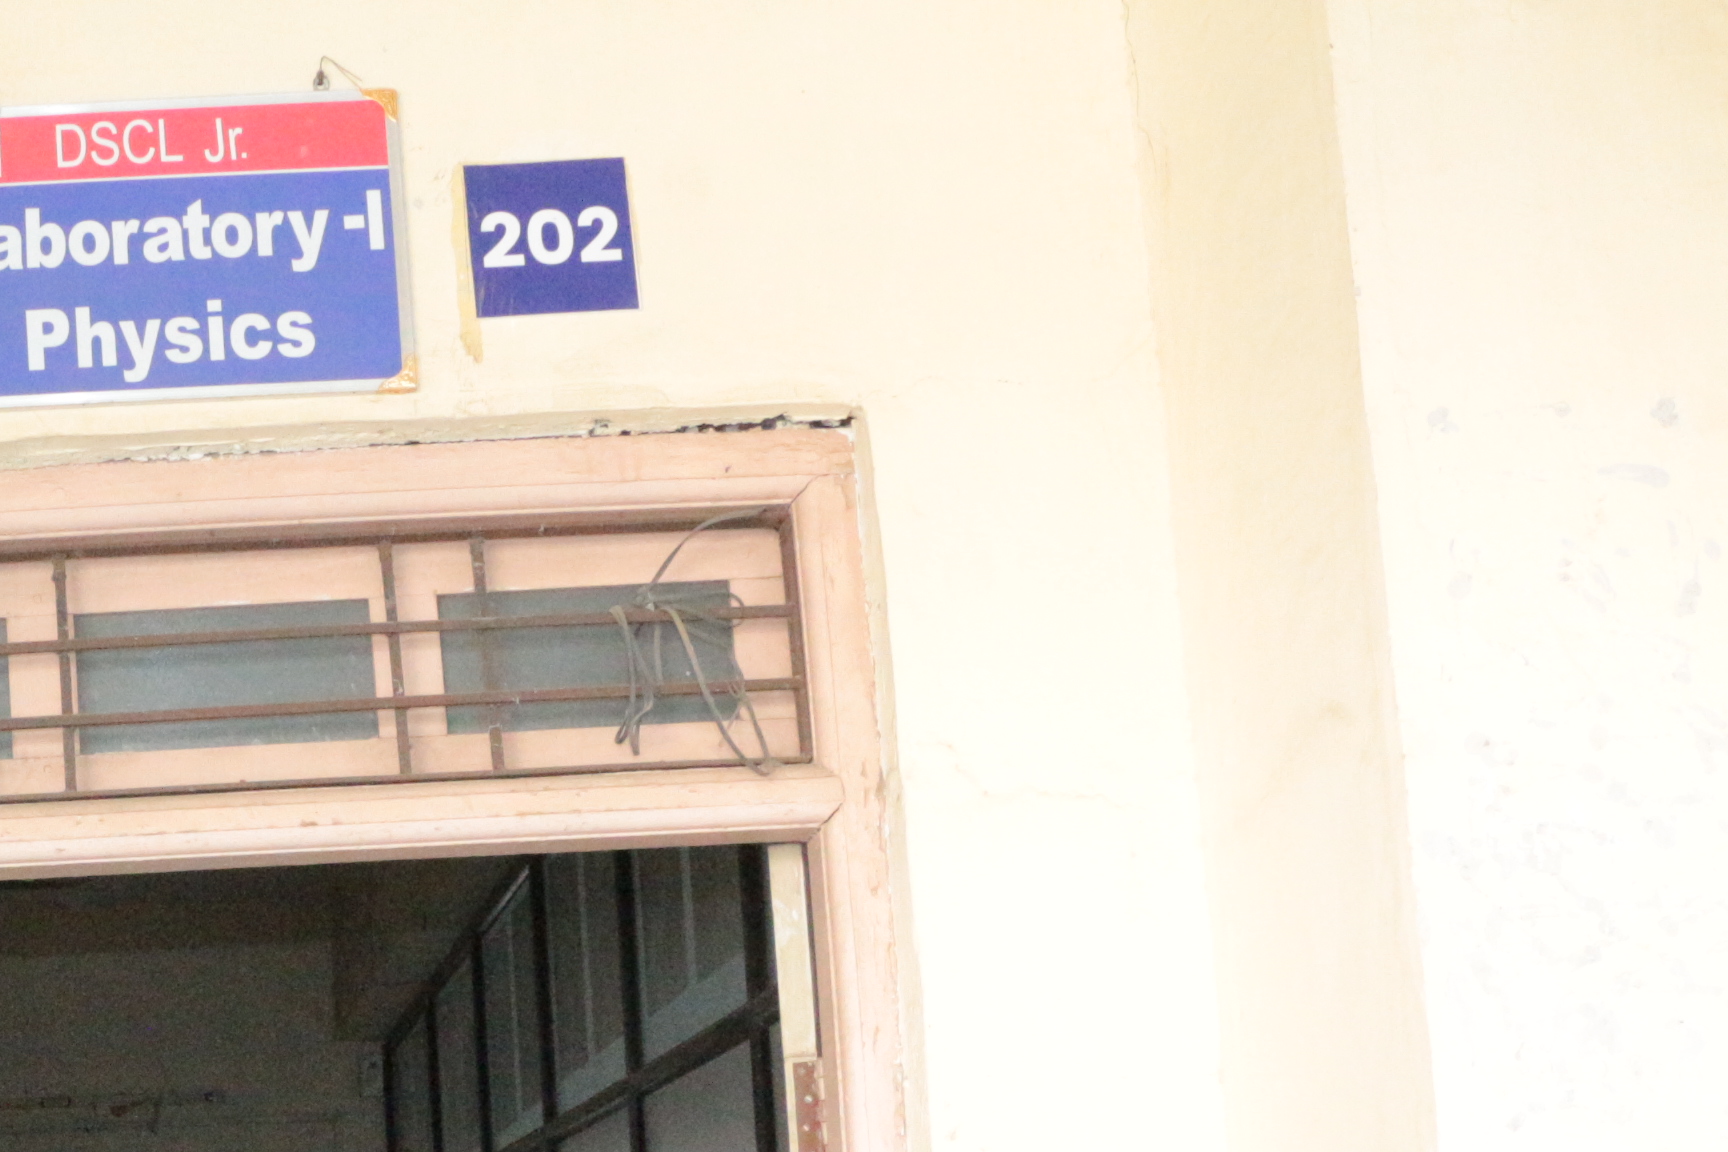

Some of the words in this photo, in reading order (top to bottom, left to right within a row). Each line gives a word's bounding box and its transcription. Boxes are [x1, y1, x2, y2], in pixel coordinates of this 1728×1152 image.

[55, 119, 184, 168] DSCL
[204, 118, 248, 163] Jr.
[479, 205, 624, 269] 202
[25, 299, 316, 383] Physics
